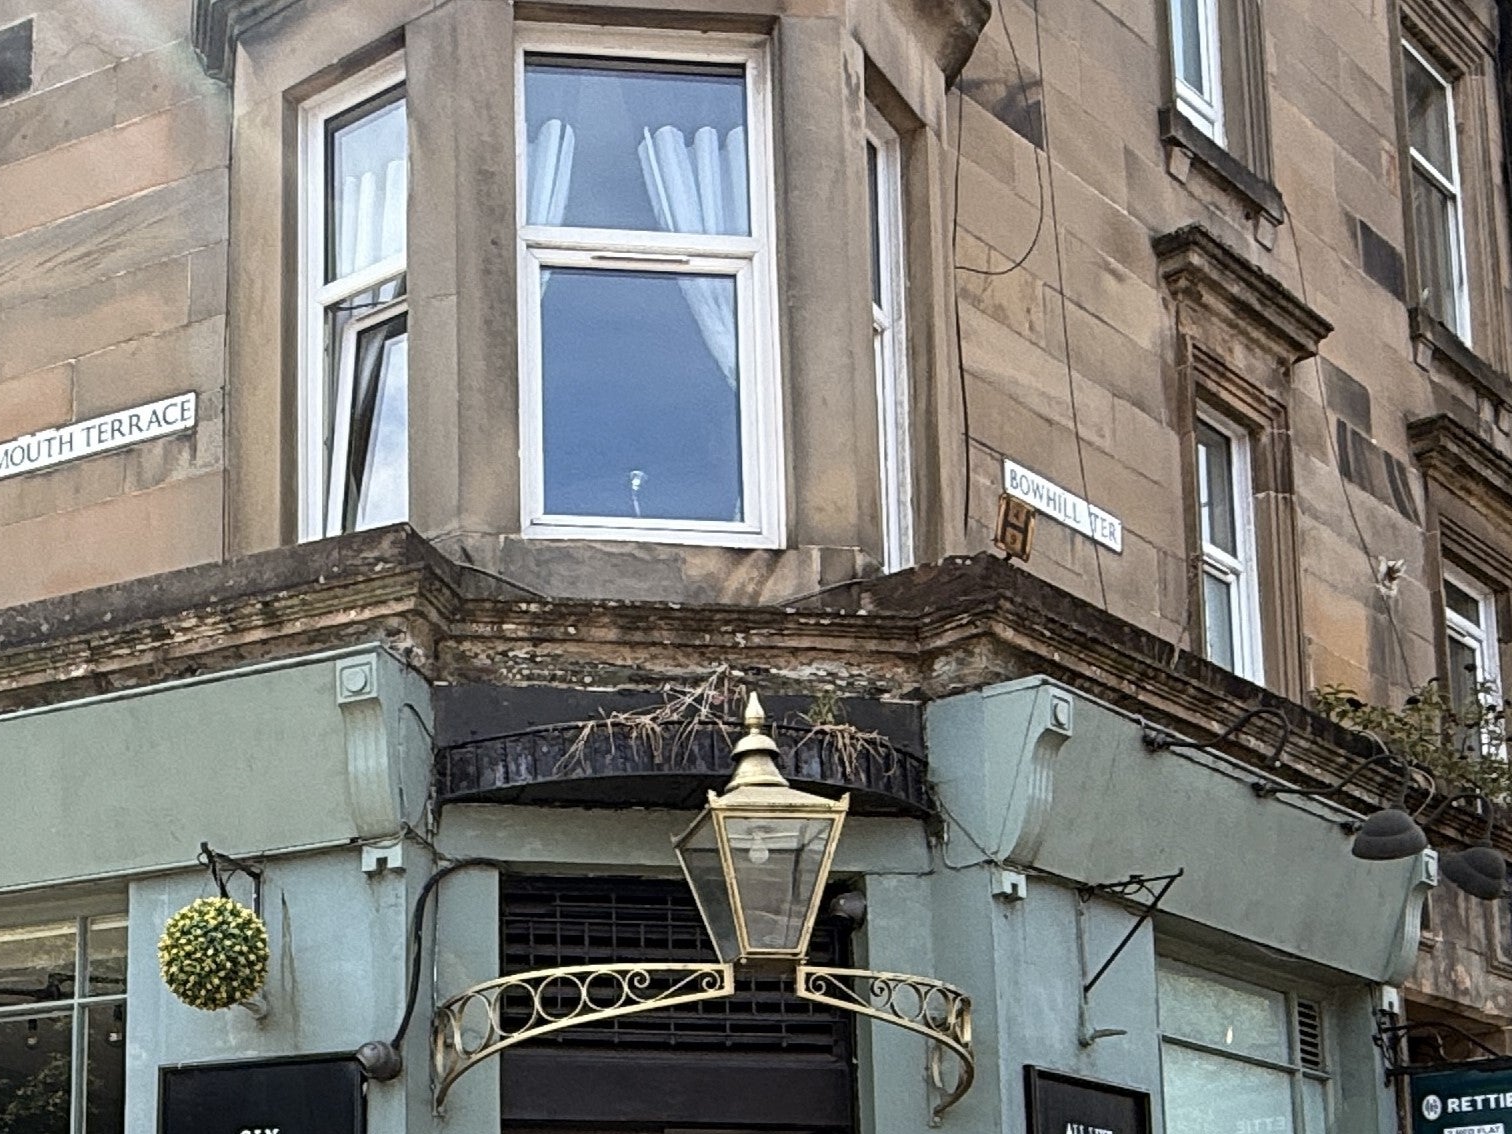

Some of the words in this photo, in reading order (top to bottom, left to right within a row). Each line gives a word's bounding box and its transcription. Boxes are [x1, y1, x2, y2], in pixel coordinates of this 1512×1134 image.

[81, 398, 193, 447] TERRACE
[1009, 469, 1081, 523] BOWHILL
[1090, 511, 1117, 543] TER
[1447, 1092, 1512, 1113] RETTIE
